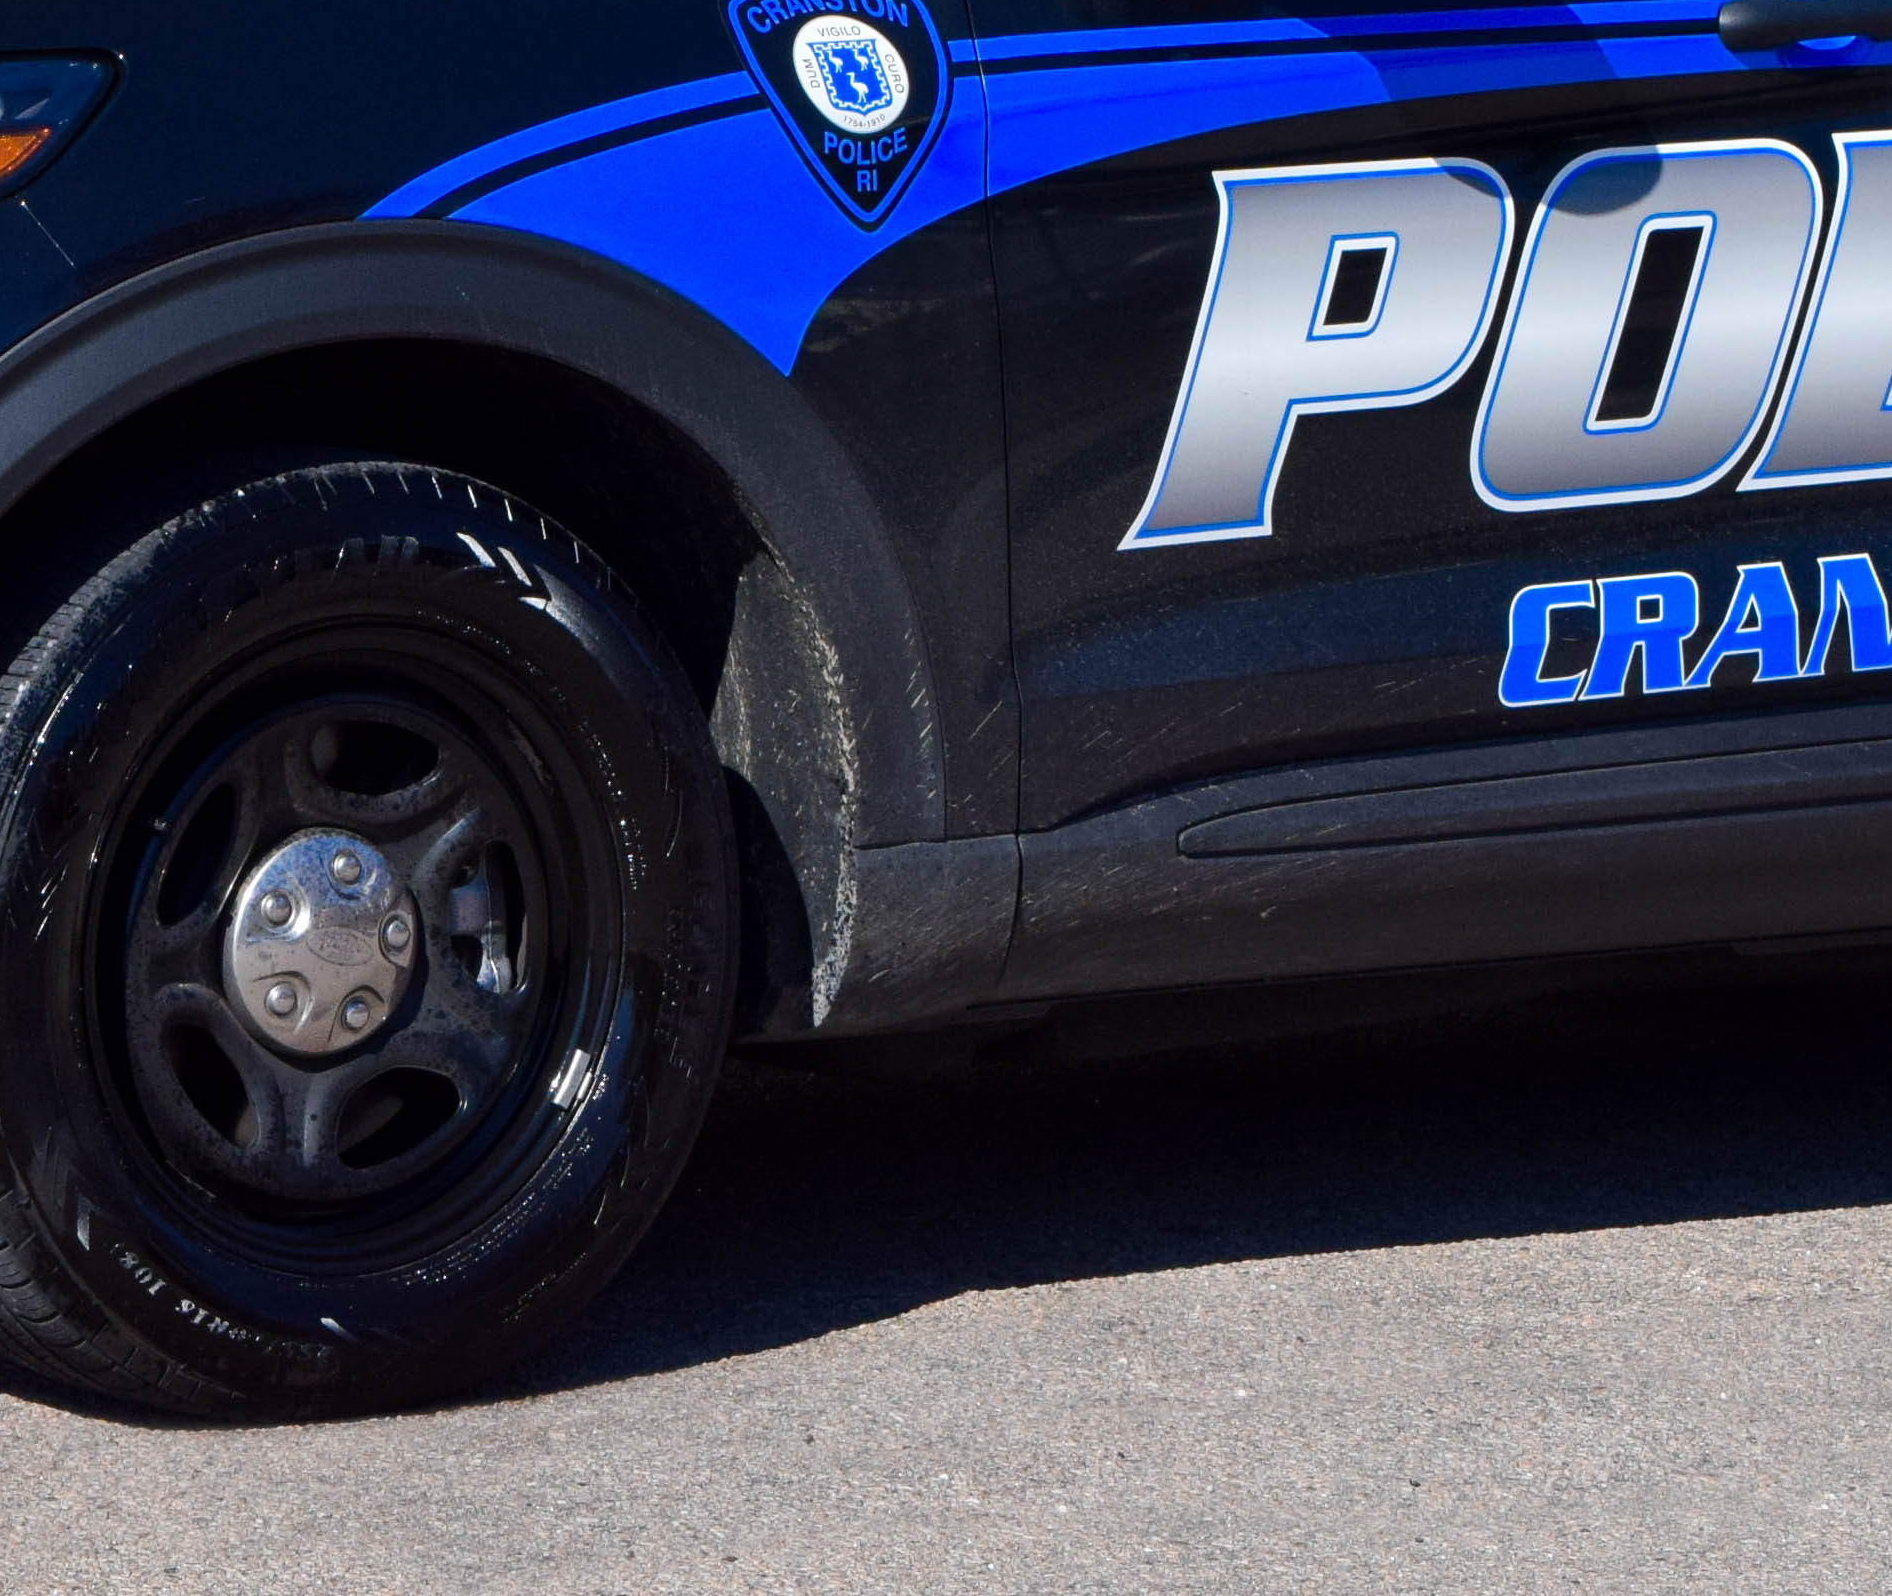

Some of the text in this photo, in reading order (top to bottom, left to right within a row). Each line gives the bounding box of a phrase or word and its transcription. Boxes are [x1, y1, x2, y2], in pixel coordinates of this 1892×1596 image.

[802, 25, 906, 94] DUM VIGILO CURO
[843, 113, 886, 129] 1754-1910
[823, 126, 909, 166] POLICE
[856, 168, 878, 192] RI
